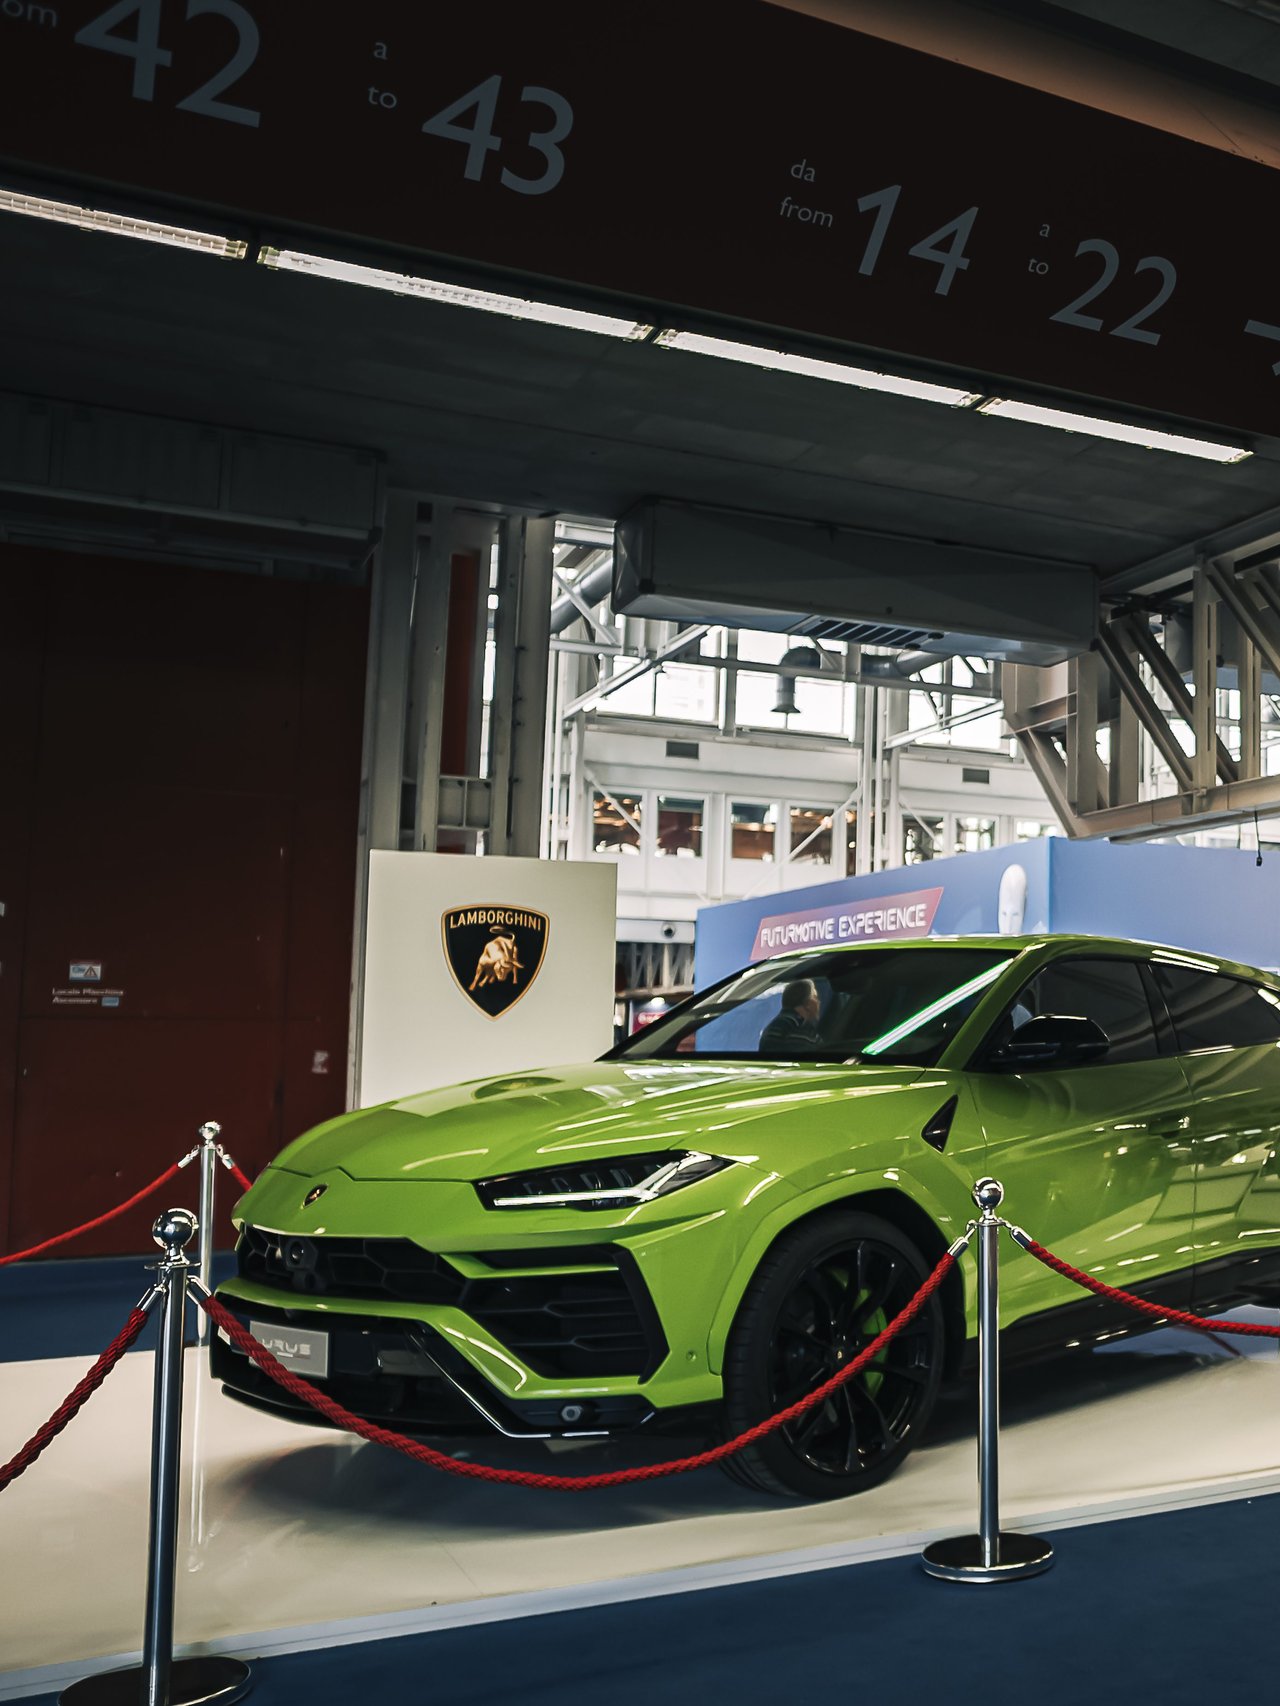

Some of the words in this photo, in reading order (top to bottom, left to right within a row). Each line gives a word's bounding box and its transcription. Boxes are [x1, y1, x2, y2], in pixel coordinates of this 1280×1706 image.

[0, 0, 58, 28] om
[74, 0, 261, 128] 42
[373, 41, 389, 61] a
[367, 86, 398, 110] to
[421, 74, 574, 195] 43
[790, 158, 816, 183] da
[779, 196, 834, 228] from
[856, 184, 979, 296] 14
[1038, 222, 1050, 238] a
[1027, 256, 1049, 275] to
[1049, 238, 1177, 346] 22
[449, 909, 541, 931] LAMBORGHINI
[760, 917, 836, 949] FUTURMOTIVE
[838, 903, 928, 938] EXPERIENCE
